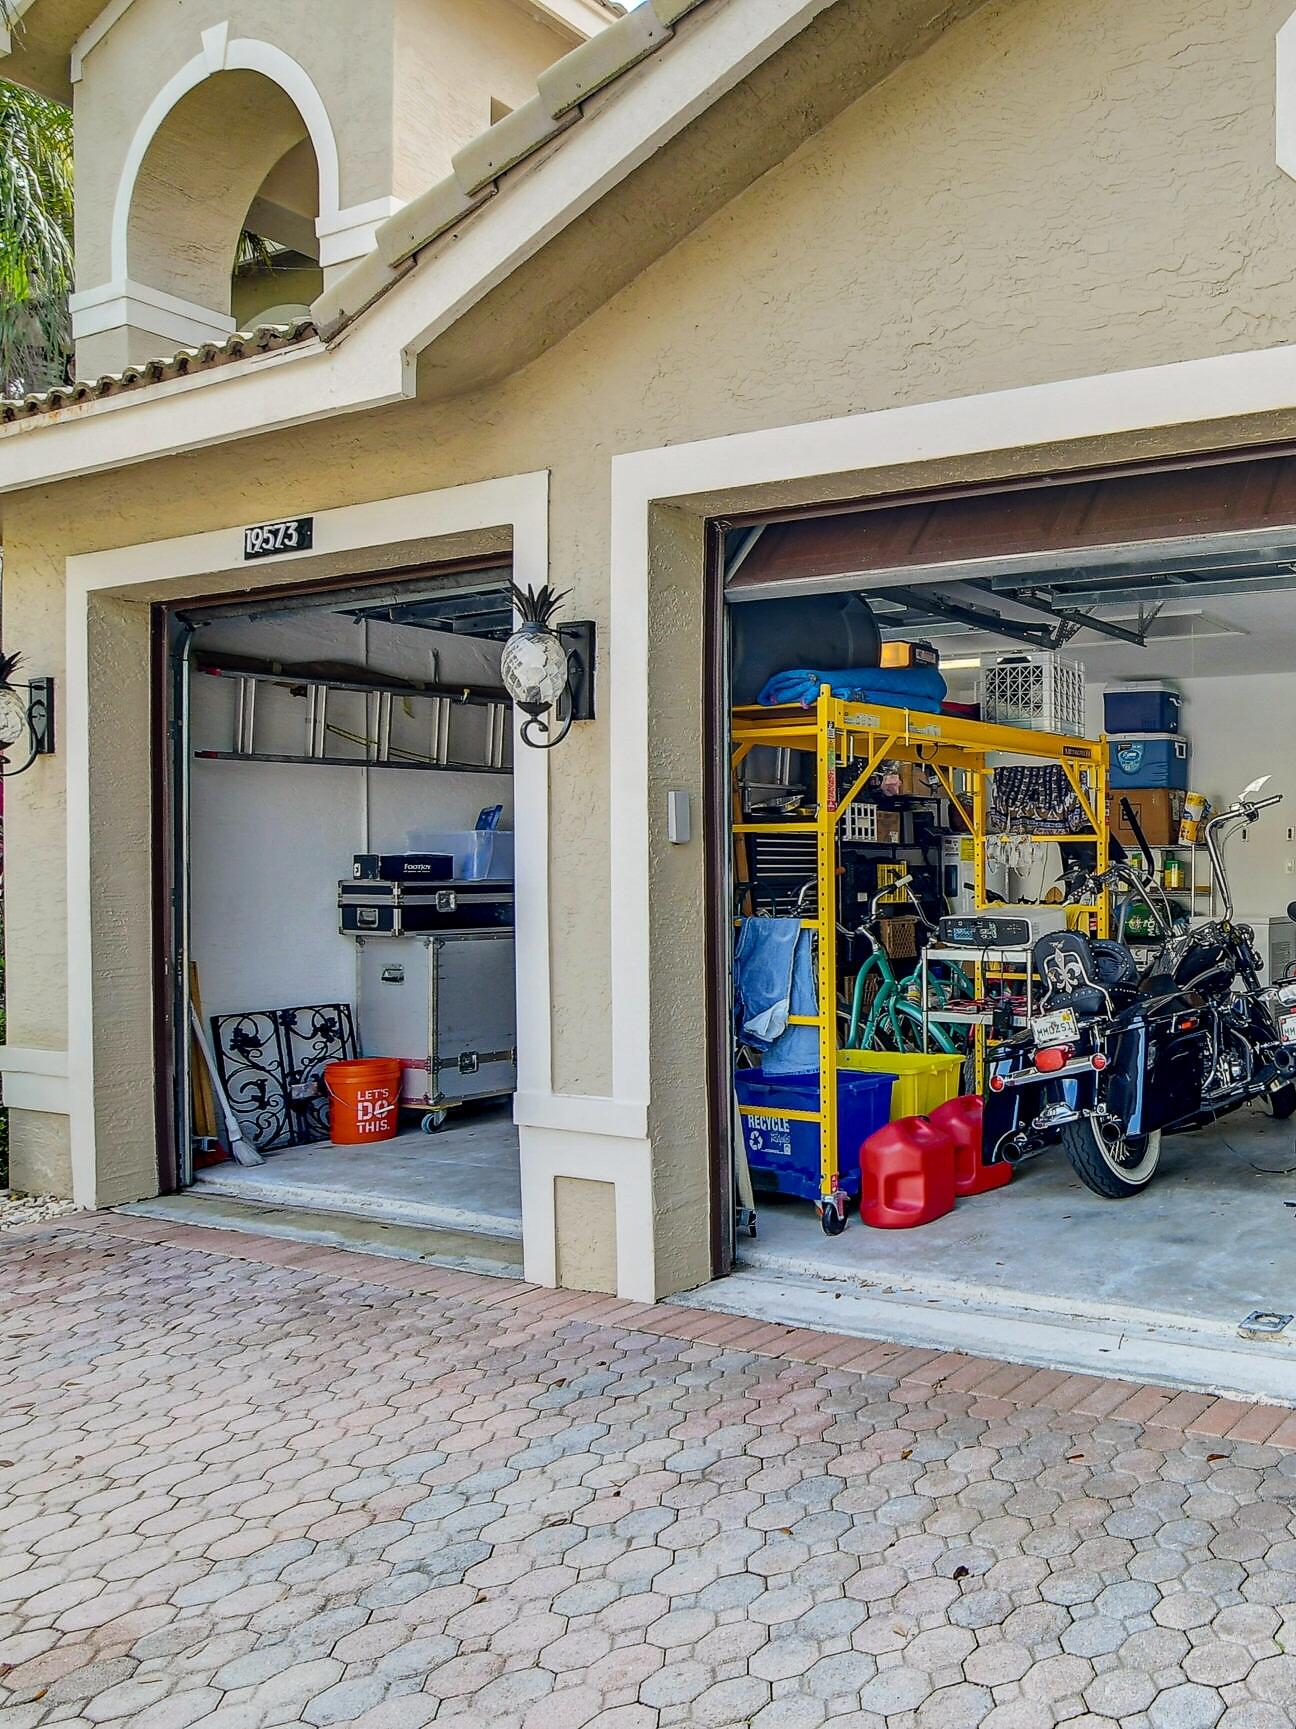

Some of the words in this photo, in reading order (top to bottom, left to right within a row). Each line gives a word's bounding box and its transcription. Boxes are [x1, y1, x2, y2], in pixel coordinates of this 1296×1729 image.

[246, 522, 298, 553] 19573
[357, 1088, 389, 1101] LET'S
[357, 1100, 390, 1121] DO
[356, 1119, 390, 1134] THIS.
[748, 1115, 790, 1133] RECYCLE
